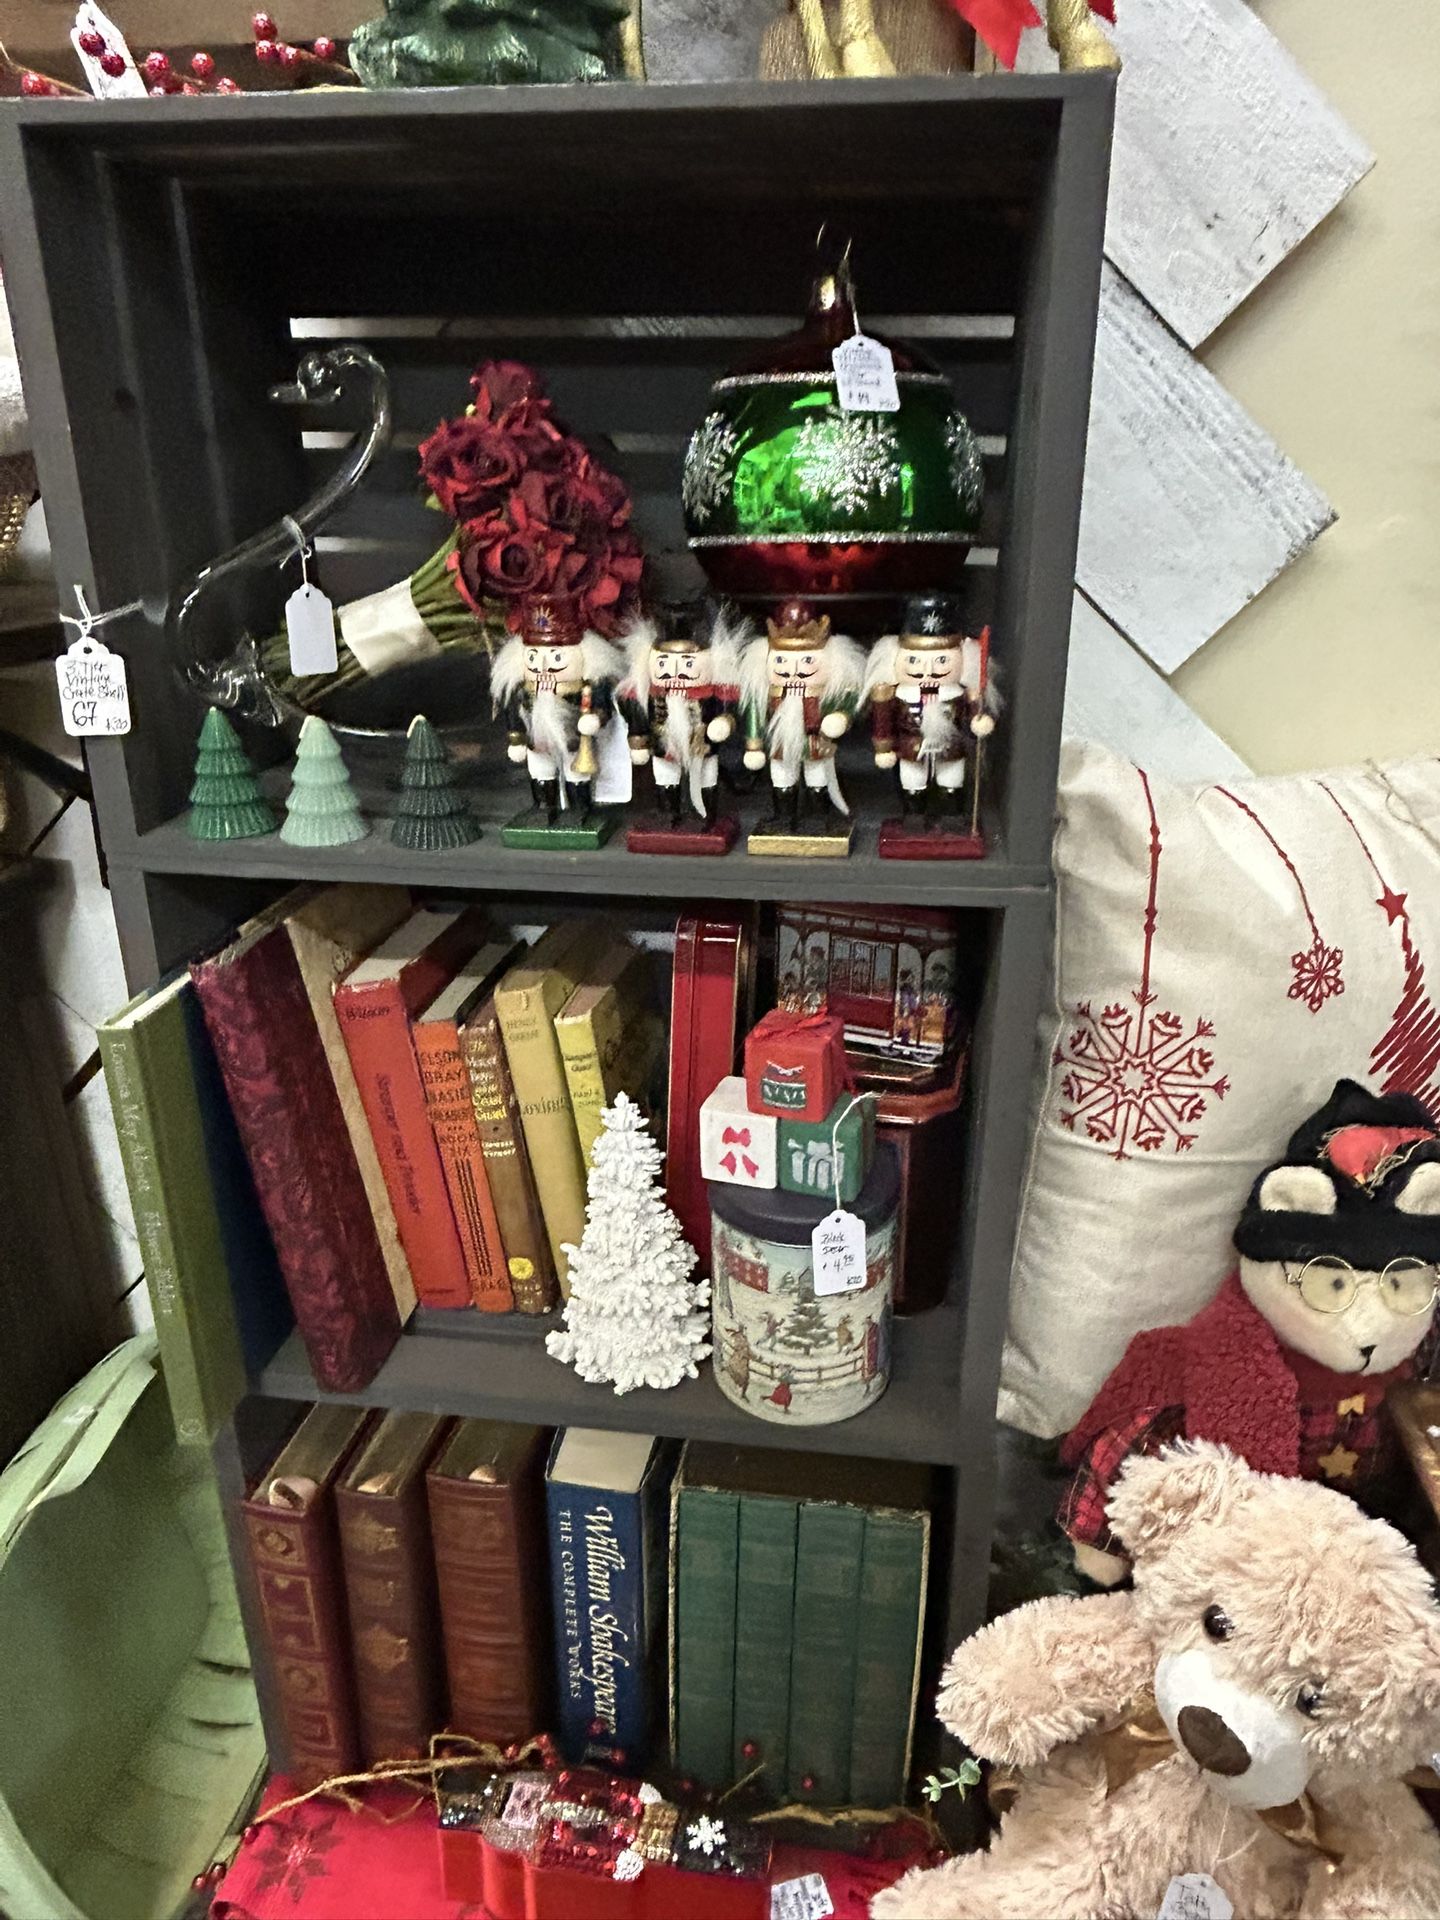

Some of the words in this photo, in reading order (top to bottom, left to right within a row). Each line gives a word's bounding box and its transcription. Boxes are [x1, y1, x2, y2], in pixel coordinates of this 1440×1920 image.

[559, 1509, 573, 1543] THE
[584, 1505, 625, 1601] William
[561, 1551, 578, 1637] COMPLETE
[567, 1640, 582, 1698] WORKS
